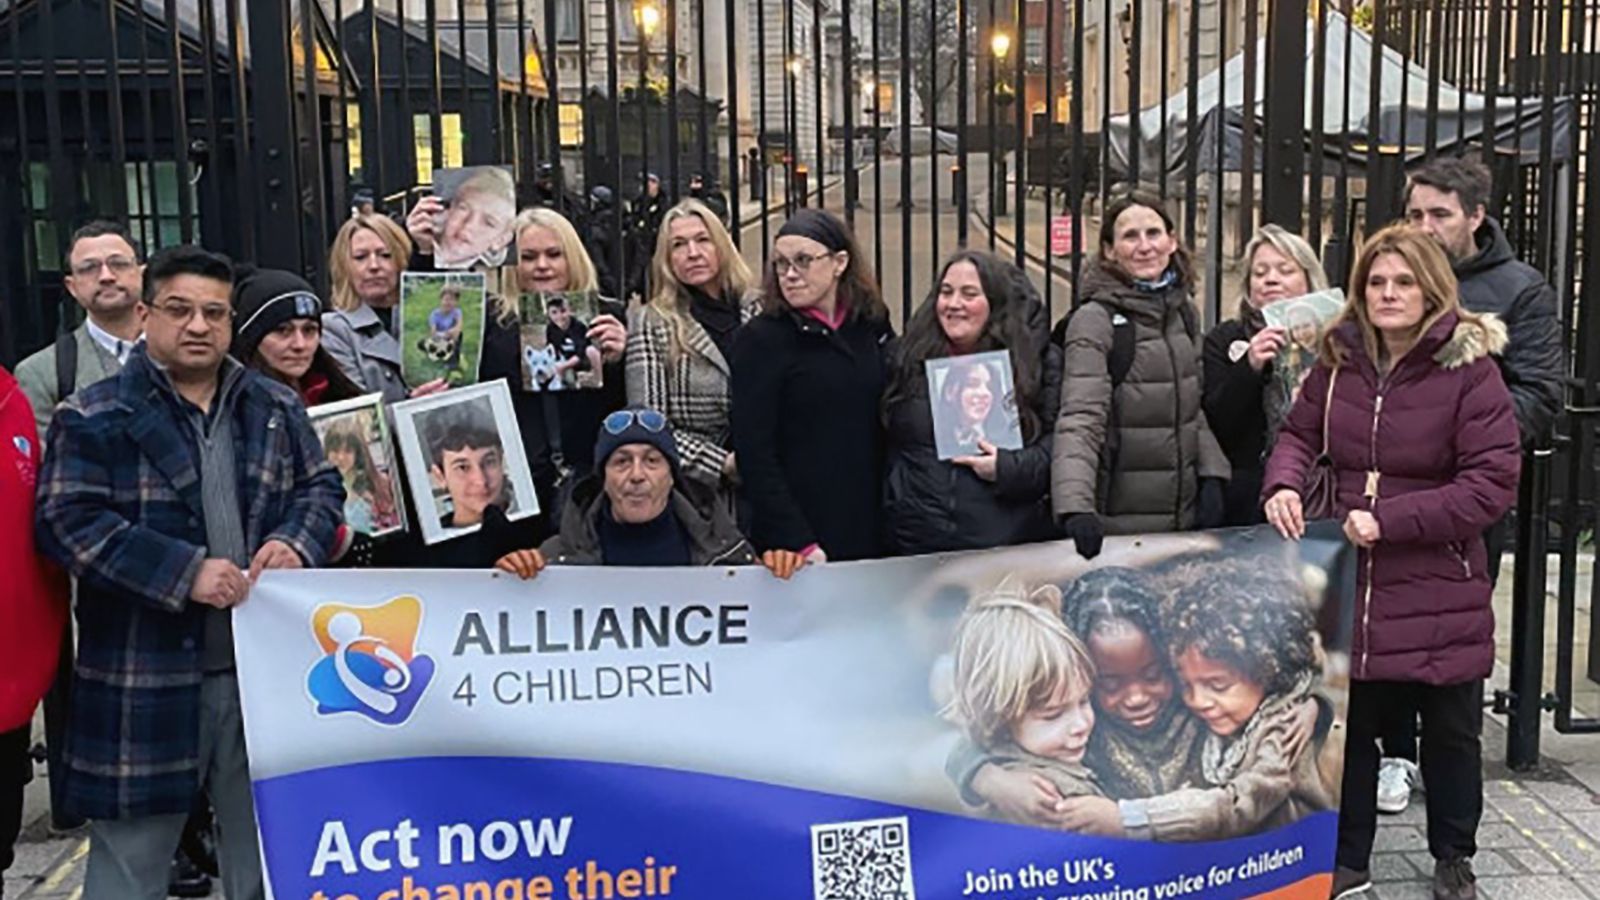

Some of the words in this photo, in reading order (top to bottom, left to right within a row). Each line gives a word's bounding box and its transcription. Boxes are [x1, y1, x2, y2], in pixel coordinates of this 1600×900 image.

[452, 604, 750, 656] ALLIANCE
[452, 673, 477, 707] 4
[493, 661, 713, 705] CHILDREN
[309, 818, 420, 877] Act
[438, 815, 573, 866] now
[564, 856, 677, 900] their
[962, 871, 1014, 895] Join
[1018, 864, 1059, 889] the
[1064, 857, 1115, 883] UK's
[1057, 884, 1149, 900] owing
[1153, 874, 1205, 899] voice
[1207, 866, 1235, 887] for
[1237, 845, 1303, 879] children
